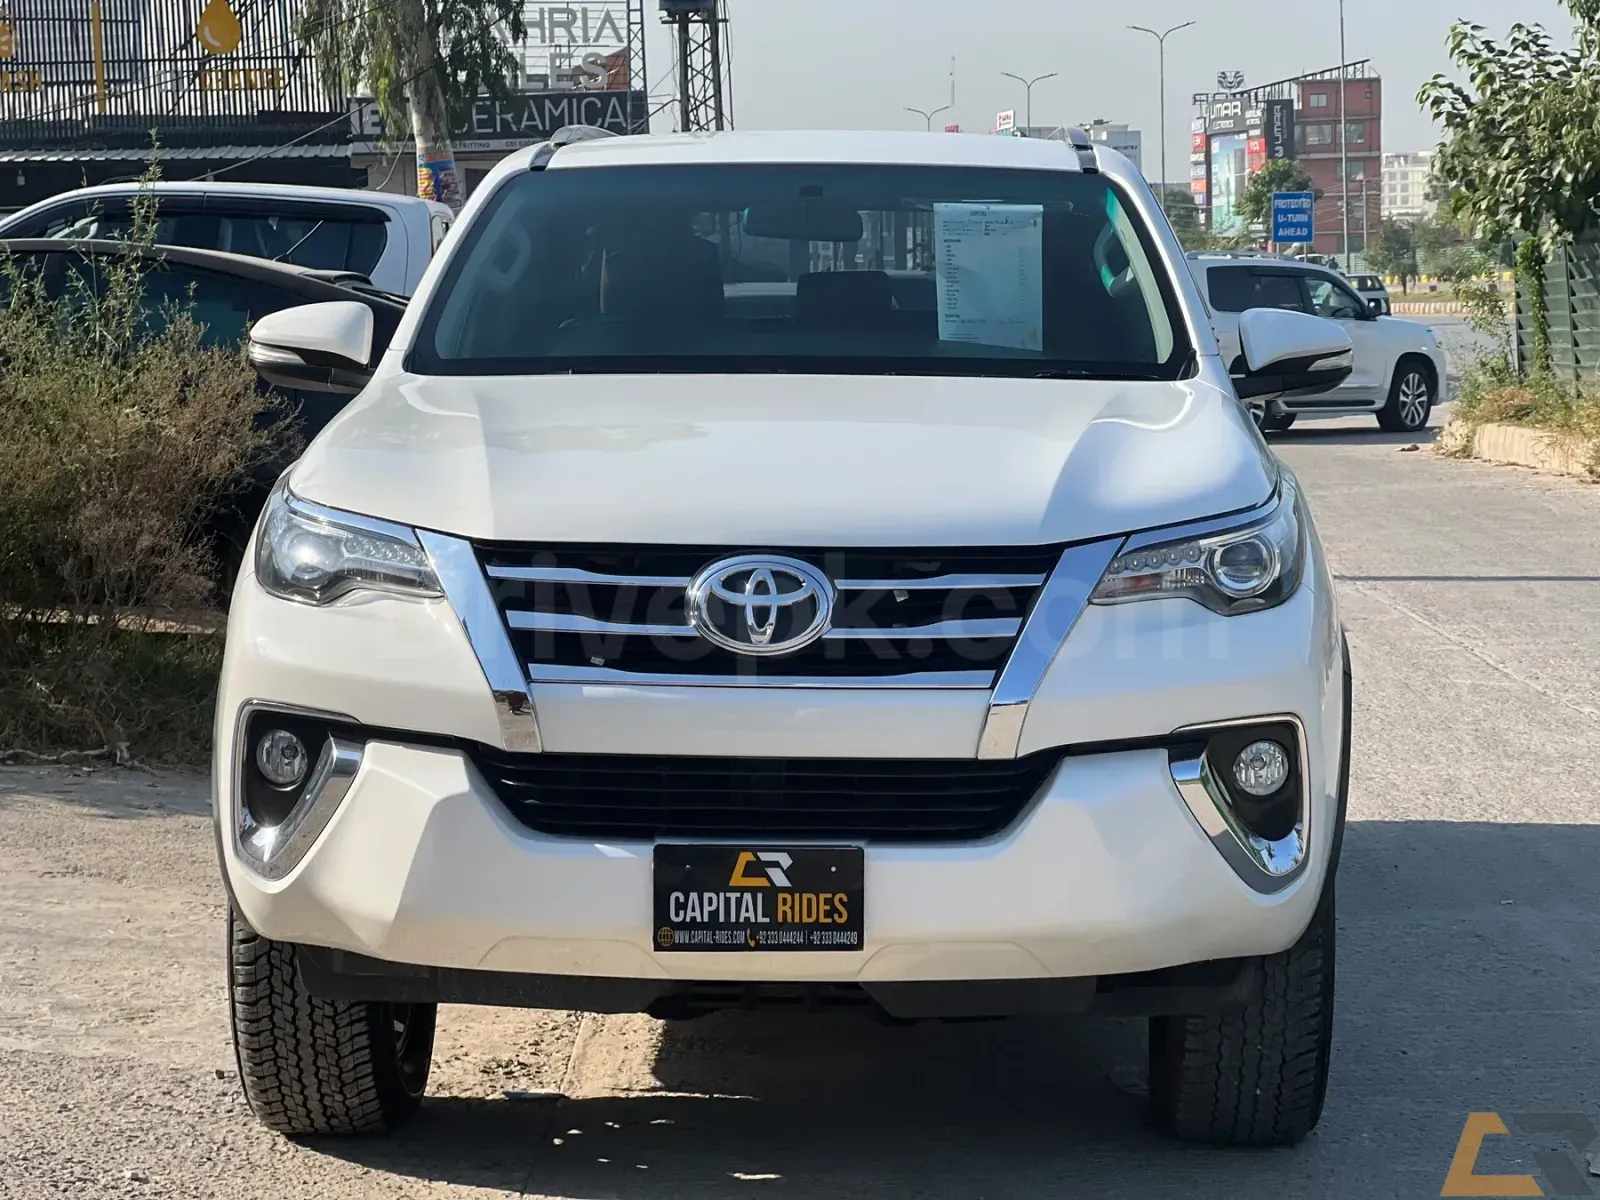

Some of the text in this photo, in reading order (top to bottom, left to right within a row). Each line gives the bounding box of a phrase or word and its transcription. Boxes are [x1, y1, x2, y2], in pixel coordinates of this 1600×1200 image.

[489, 7, 625, 44] AHRIA
[0, 70, 42, 92] ASH
[519, 52, 607, 89] LES
[453, 96, 627, 134] ERAMICA
[1277, 213, 1308, 222] U-TURN
[1278, 227, 1307, 236] AHEAD
[669, 892, 848, 923] CAPITAL RIDES
[674, 930, 745, 944] WWW.CAPITAL-RIDES.COM
